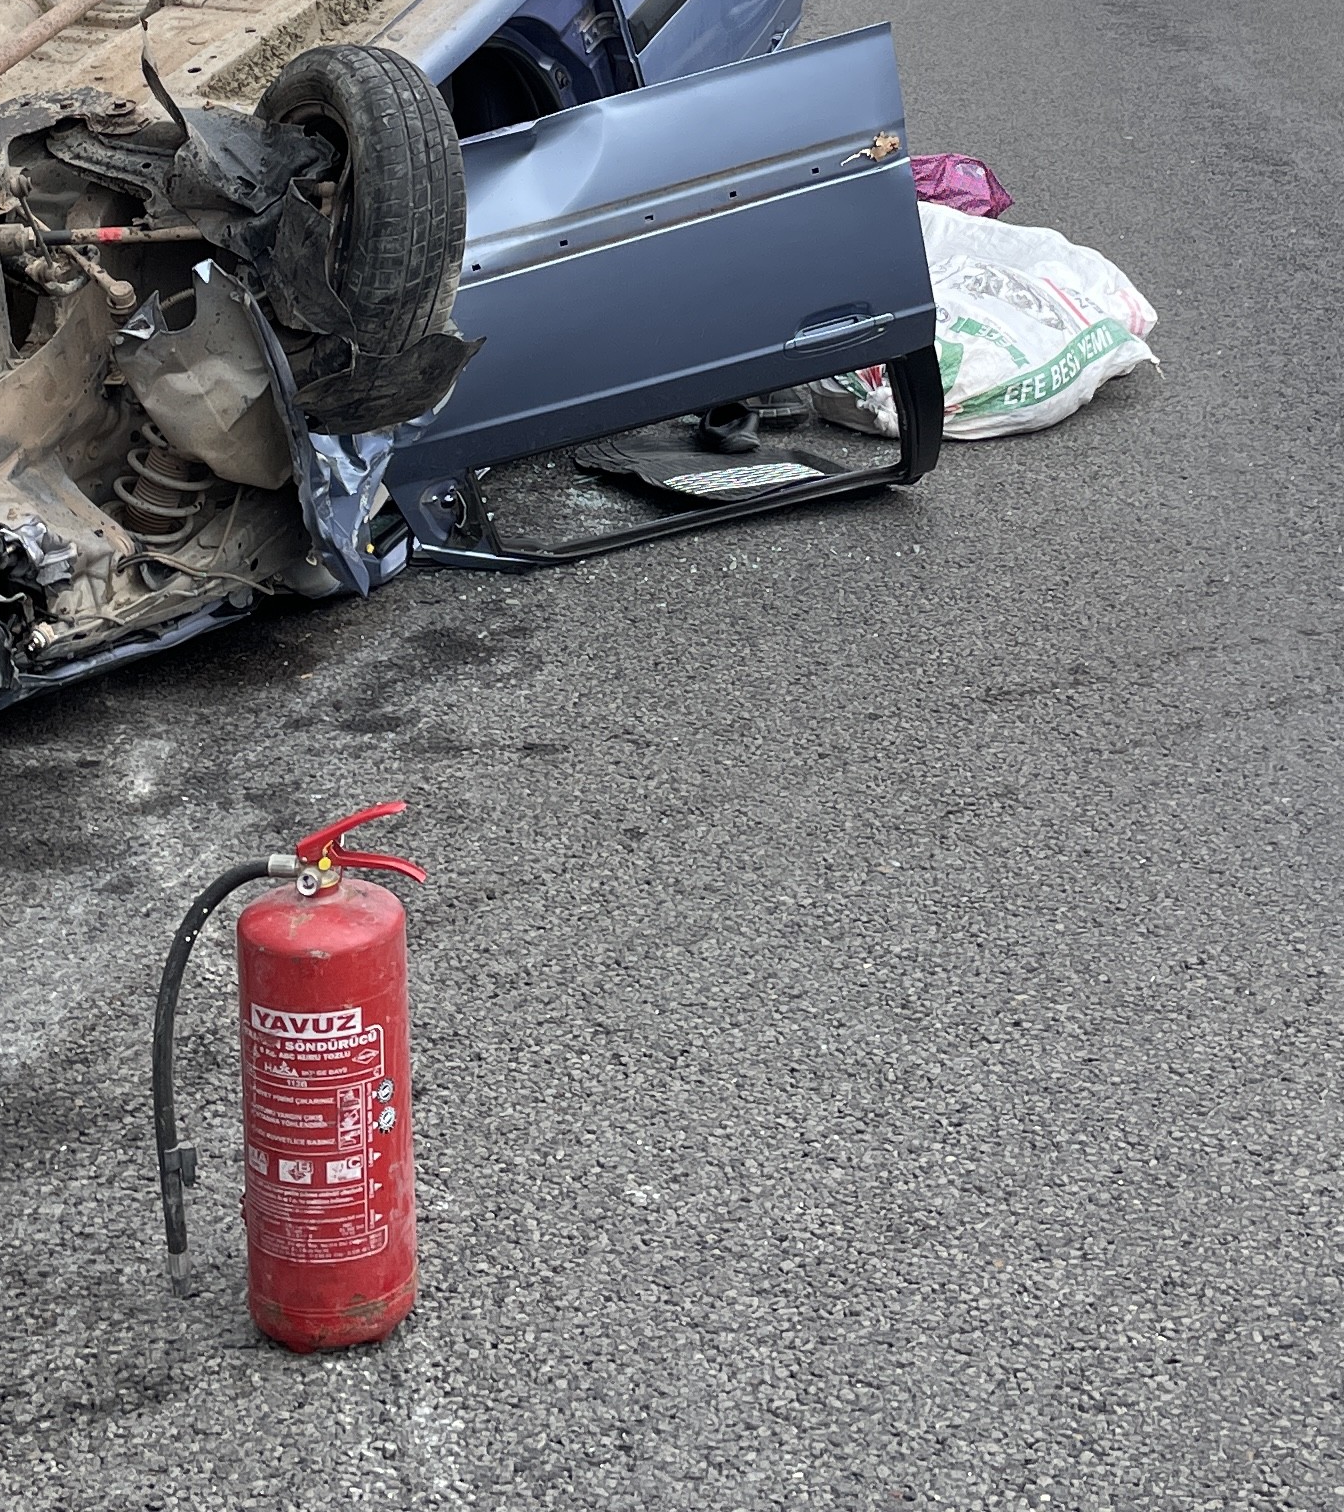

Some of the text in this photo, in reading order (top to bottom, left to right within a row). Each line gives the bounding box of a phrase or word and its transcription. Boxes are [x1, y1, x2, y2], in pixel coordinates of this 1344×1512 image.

[1003, 372, 1047, 405] EFE
[255, 1008, 358, 1035] YAVUZ
[284, 1030, 378, 1052] SÖNDÜRÜCÜ
[278, 1052, 296, 1061] ABC
[296, 1053, 322, 1061] KURU
[322, 1050, 352, 1061] TOZLU
